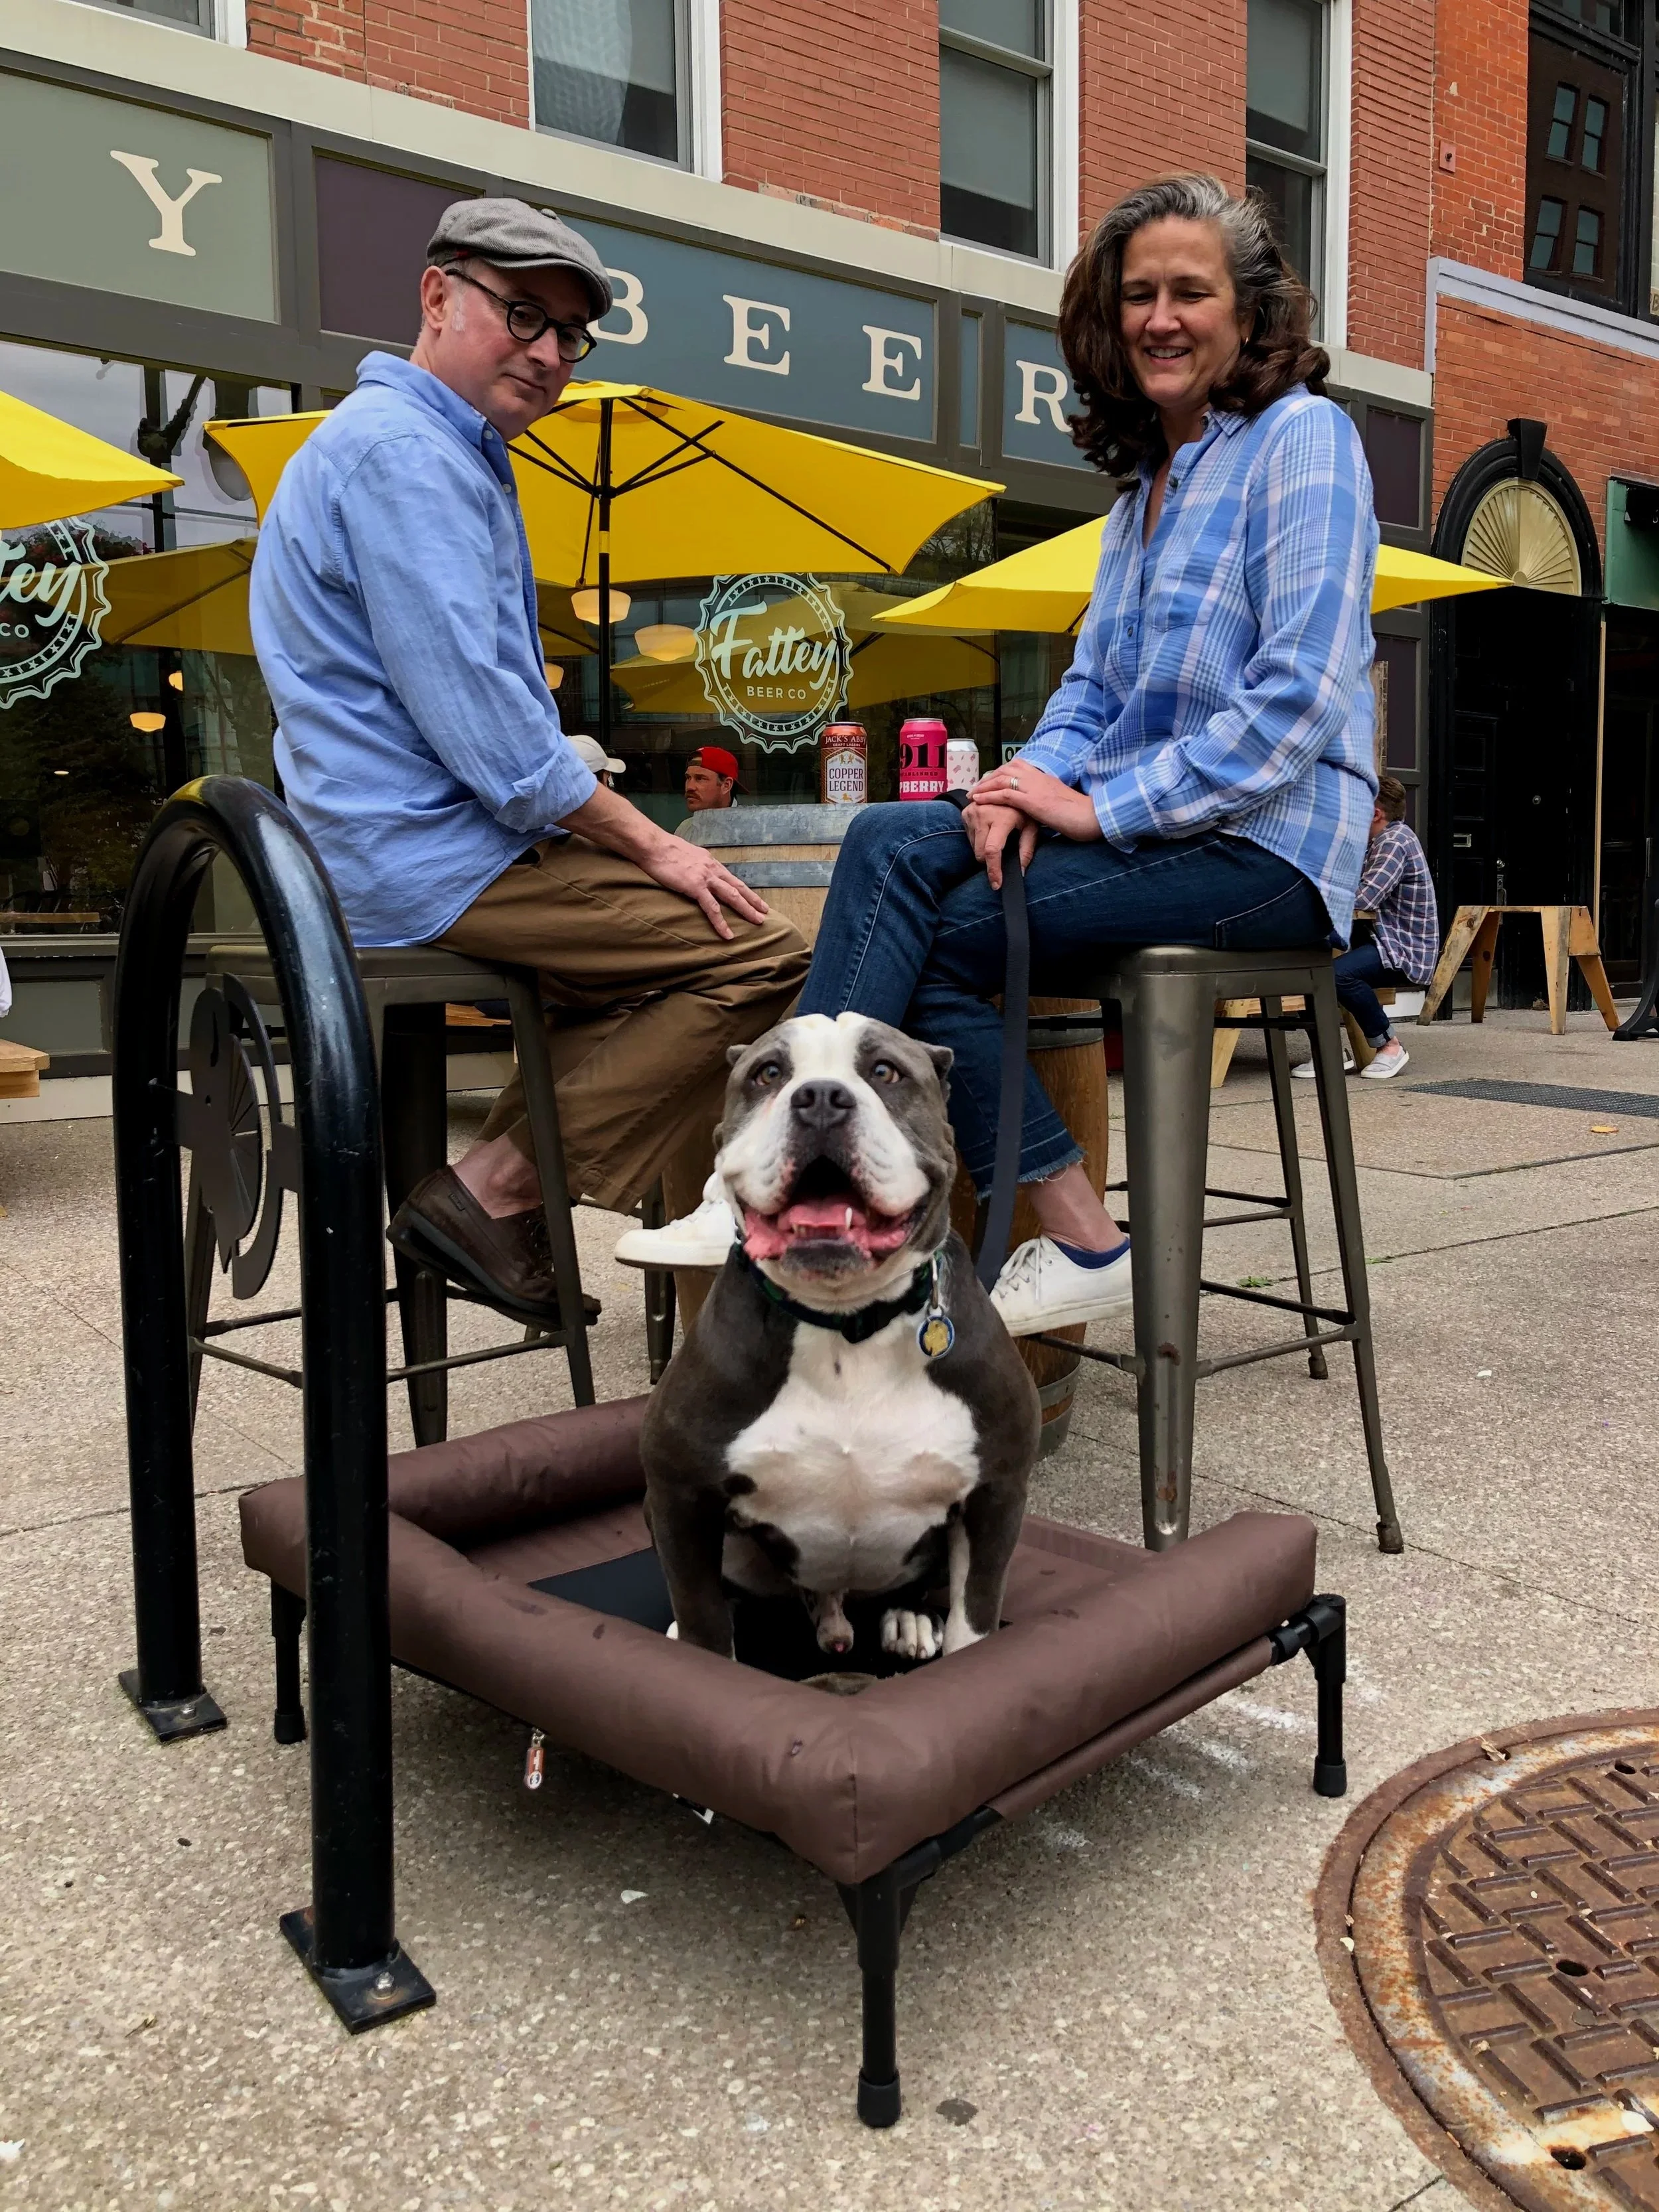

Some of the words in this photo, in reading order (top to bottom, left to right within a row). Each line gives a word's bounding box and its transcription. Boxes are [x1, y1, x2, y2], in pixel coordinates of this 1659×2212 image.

[586, 267, 1072, 432] BEER
[709, 600, 837, 691] Fattey
[747, 686, 784, 699] BEER
[788, 688, 806, 700] CO
[826, 735, 848, 745] JACK'S
[1005, 747, 1022, 763] O
[829, 768, 863, 779] COPPER
[829, 780, 863, 792] LEGEND
